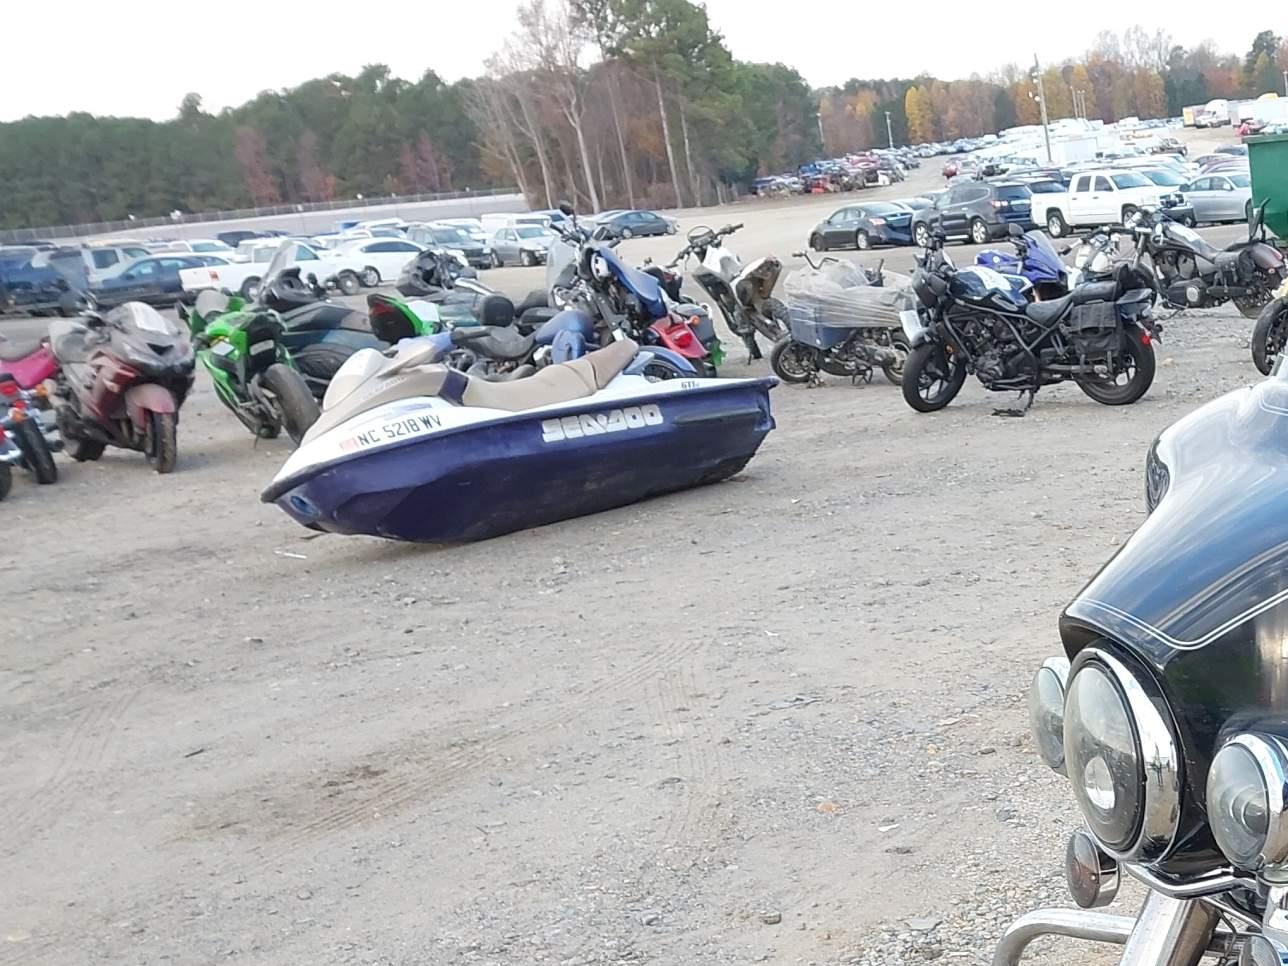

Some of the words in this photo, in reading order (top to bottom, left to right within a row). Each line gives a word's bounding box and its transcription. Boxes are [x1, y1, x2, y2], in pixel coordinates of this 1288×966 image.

[357, 430, 381, 446] NC
[382, 418, 421, 438] 5218
[417, 415, 442, 429] WV
